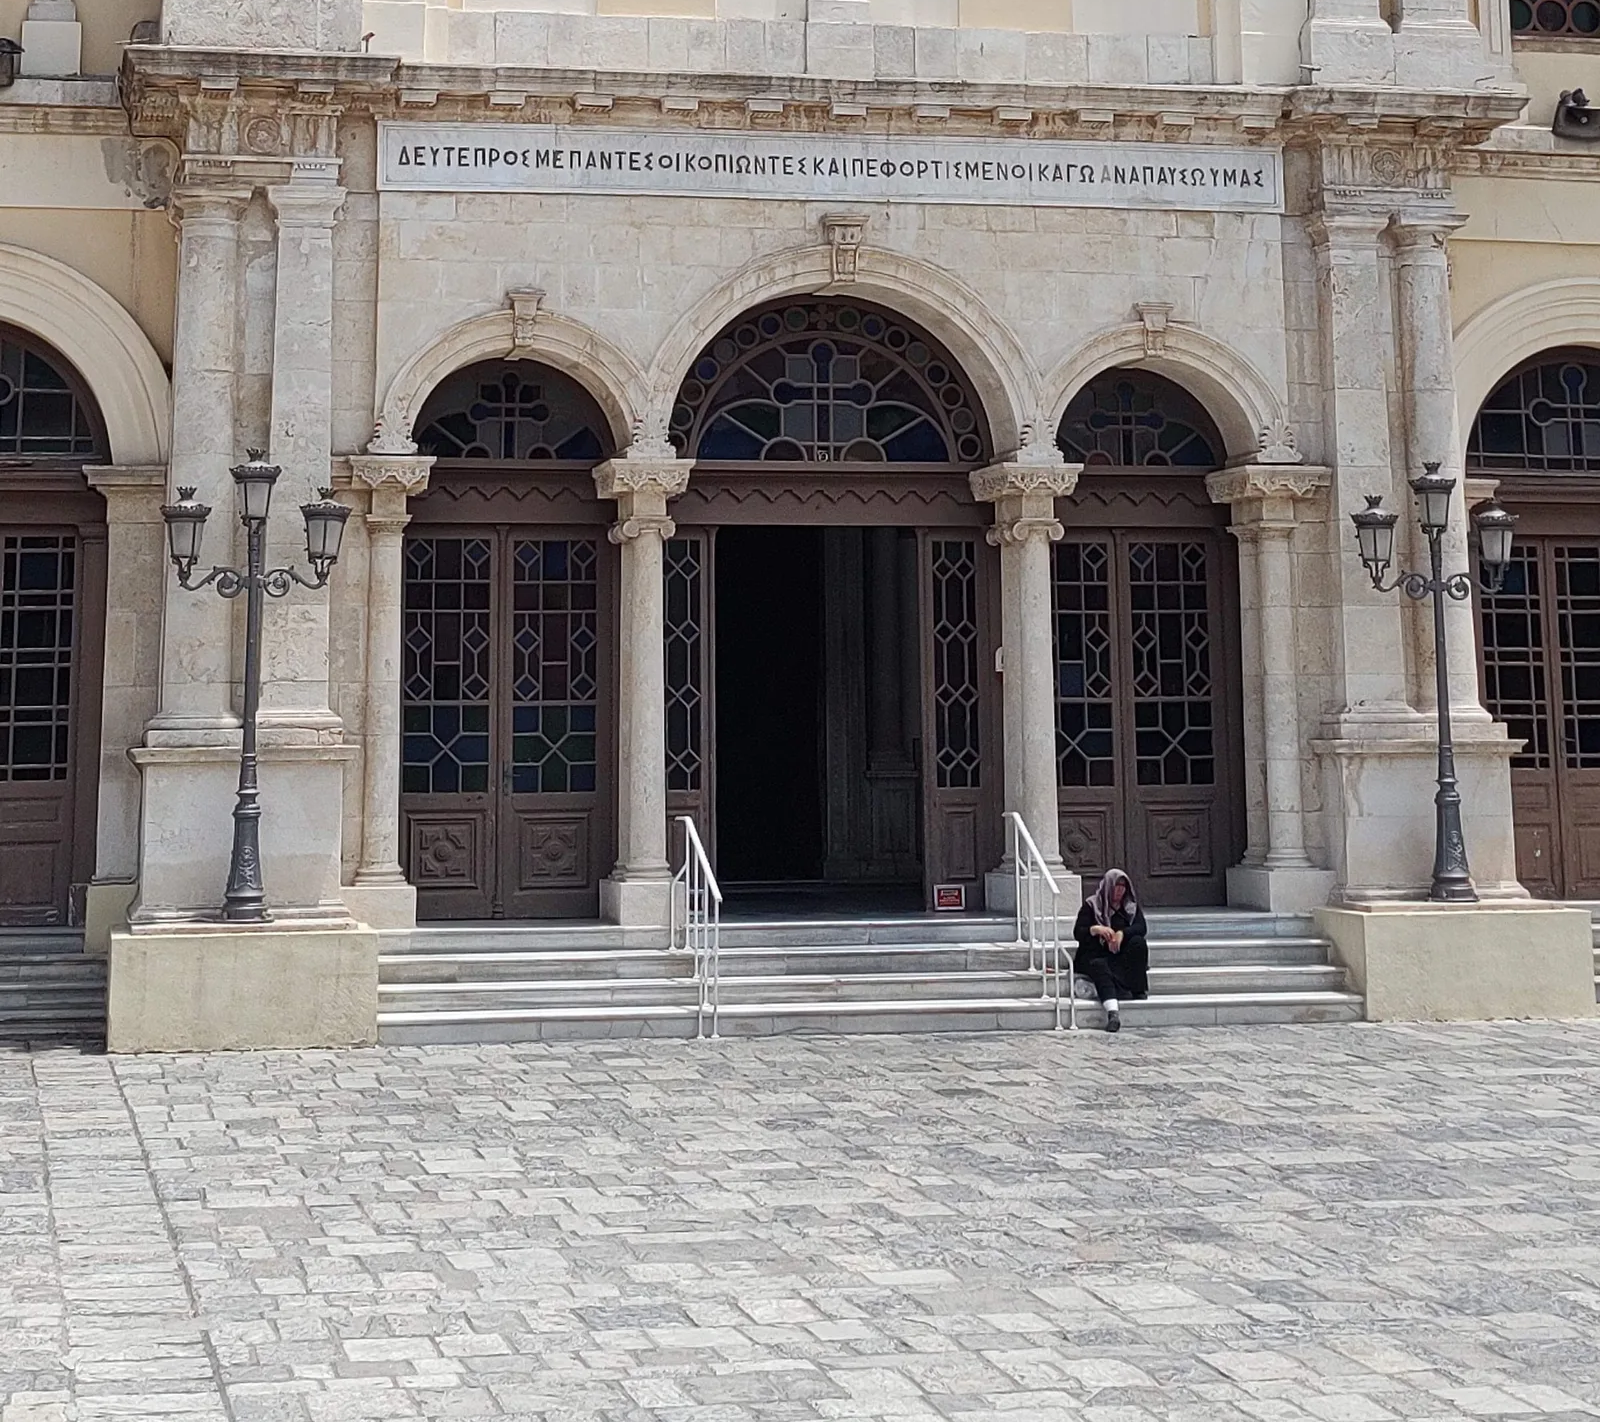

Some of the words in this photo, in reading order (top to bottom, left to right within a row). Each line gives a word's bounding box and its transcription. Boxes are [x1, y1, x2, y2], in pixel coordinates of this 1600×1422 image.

[398, 145, 470, 167] ΔΕΥΤΕ
[473, 147, 531, 168] ΠΡΟΣ
[535, 148, 565, 170] ΜΕ
[569, 150, 654, 172] ΠΑΝΤΕΣ
[658, 152, 680, 173] ΟΙ
[685, 152, 807, 176] ΚΟΠΙΩΝΤΕΣ
[813, 156, 848, 178] ΚΑΙ
[851, 158, 1033, 183] ΠΕΦΟΡΤΙΣΜΕΝΟΙ
[1038, 163, 1095, 184] ΚΑΓΩ
[1209, 167, 1264, 189] ΥΜΑΣ
